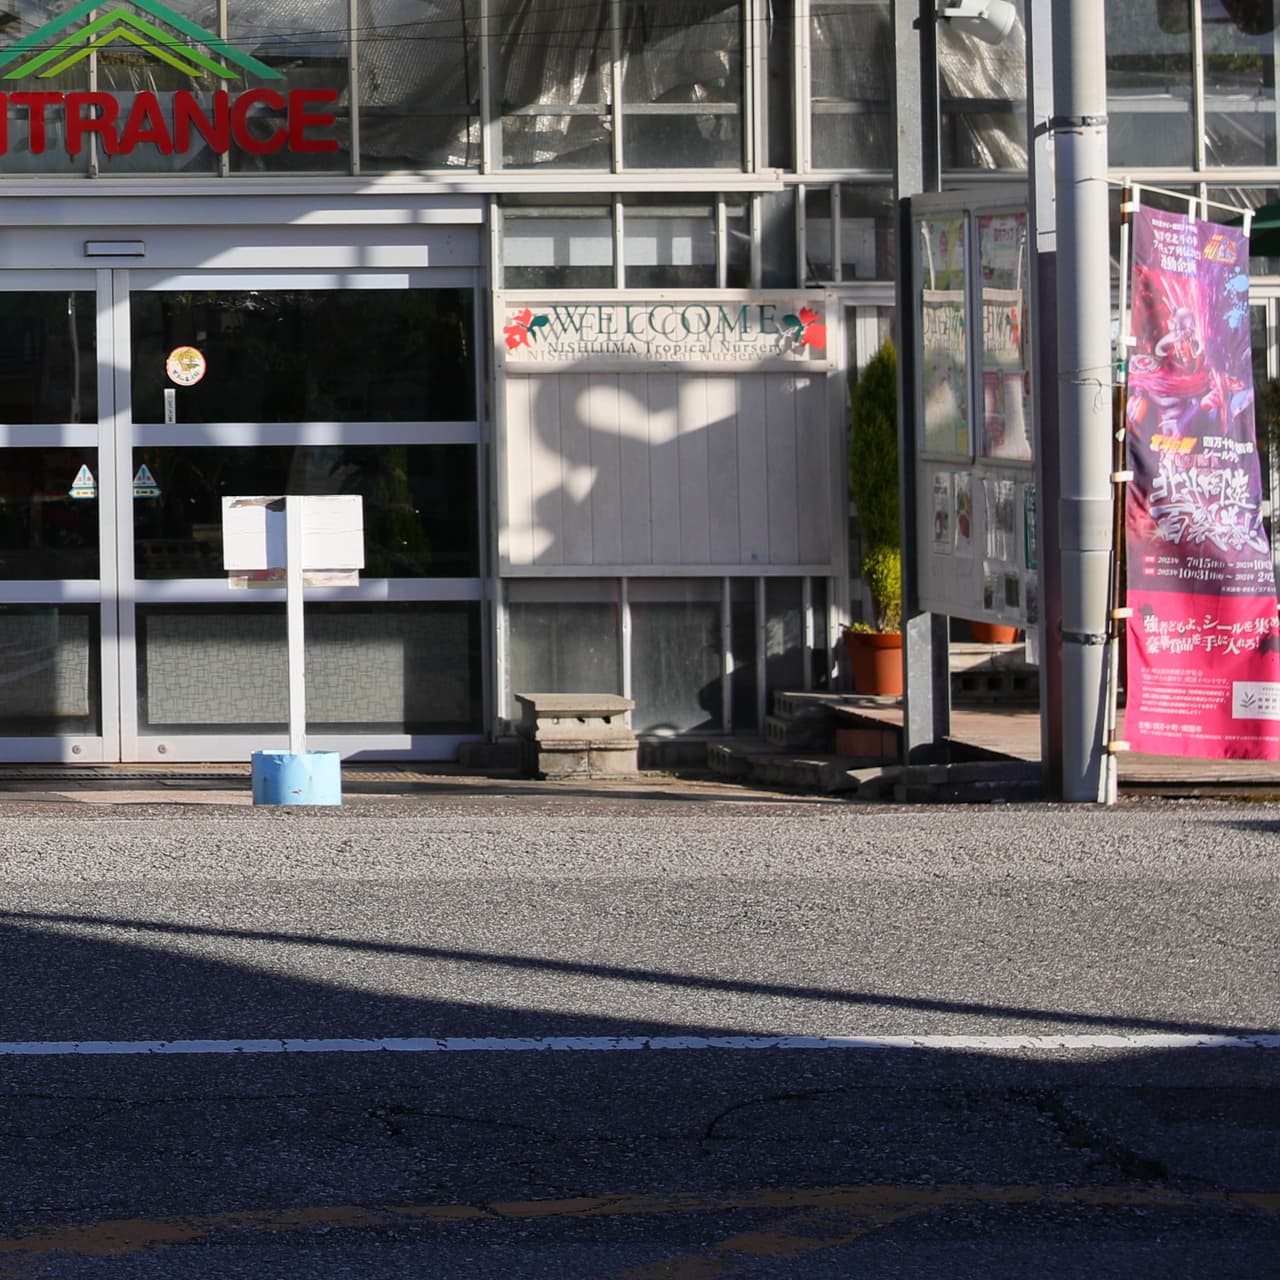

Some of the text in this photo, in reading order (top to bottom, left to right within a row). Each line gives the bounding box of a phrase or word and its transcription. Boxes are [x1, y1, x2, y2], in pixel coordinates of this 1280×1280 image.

[549, 304, 778, 335] WELCOME
[645, 340, 712, 357] Tropical
[719, 341, 782, 357] Nursery
